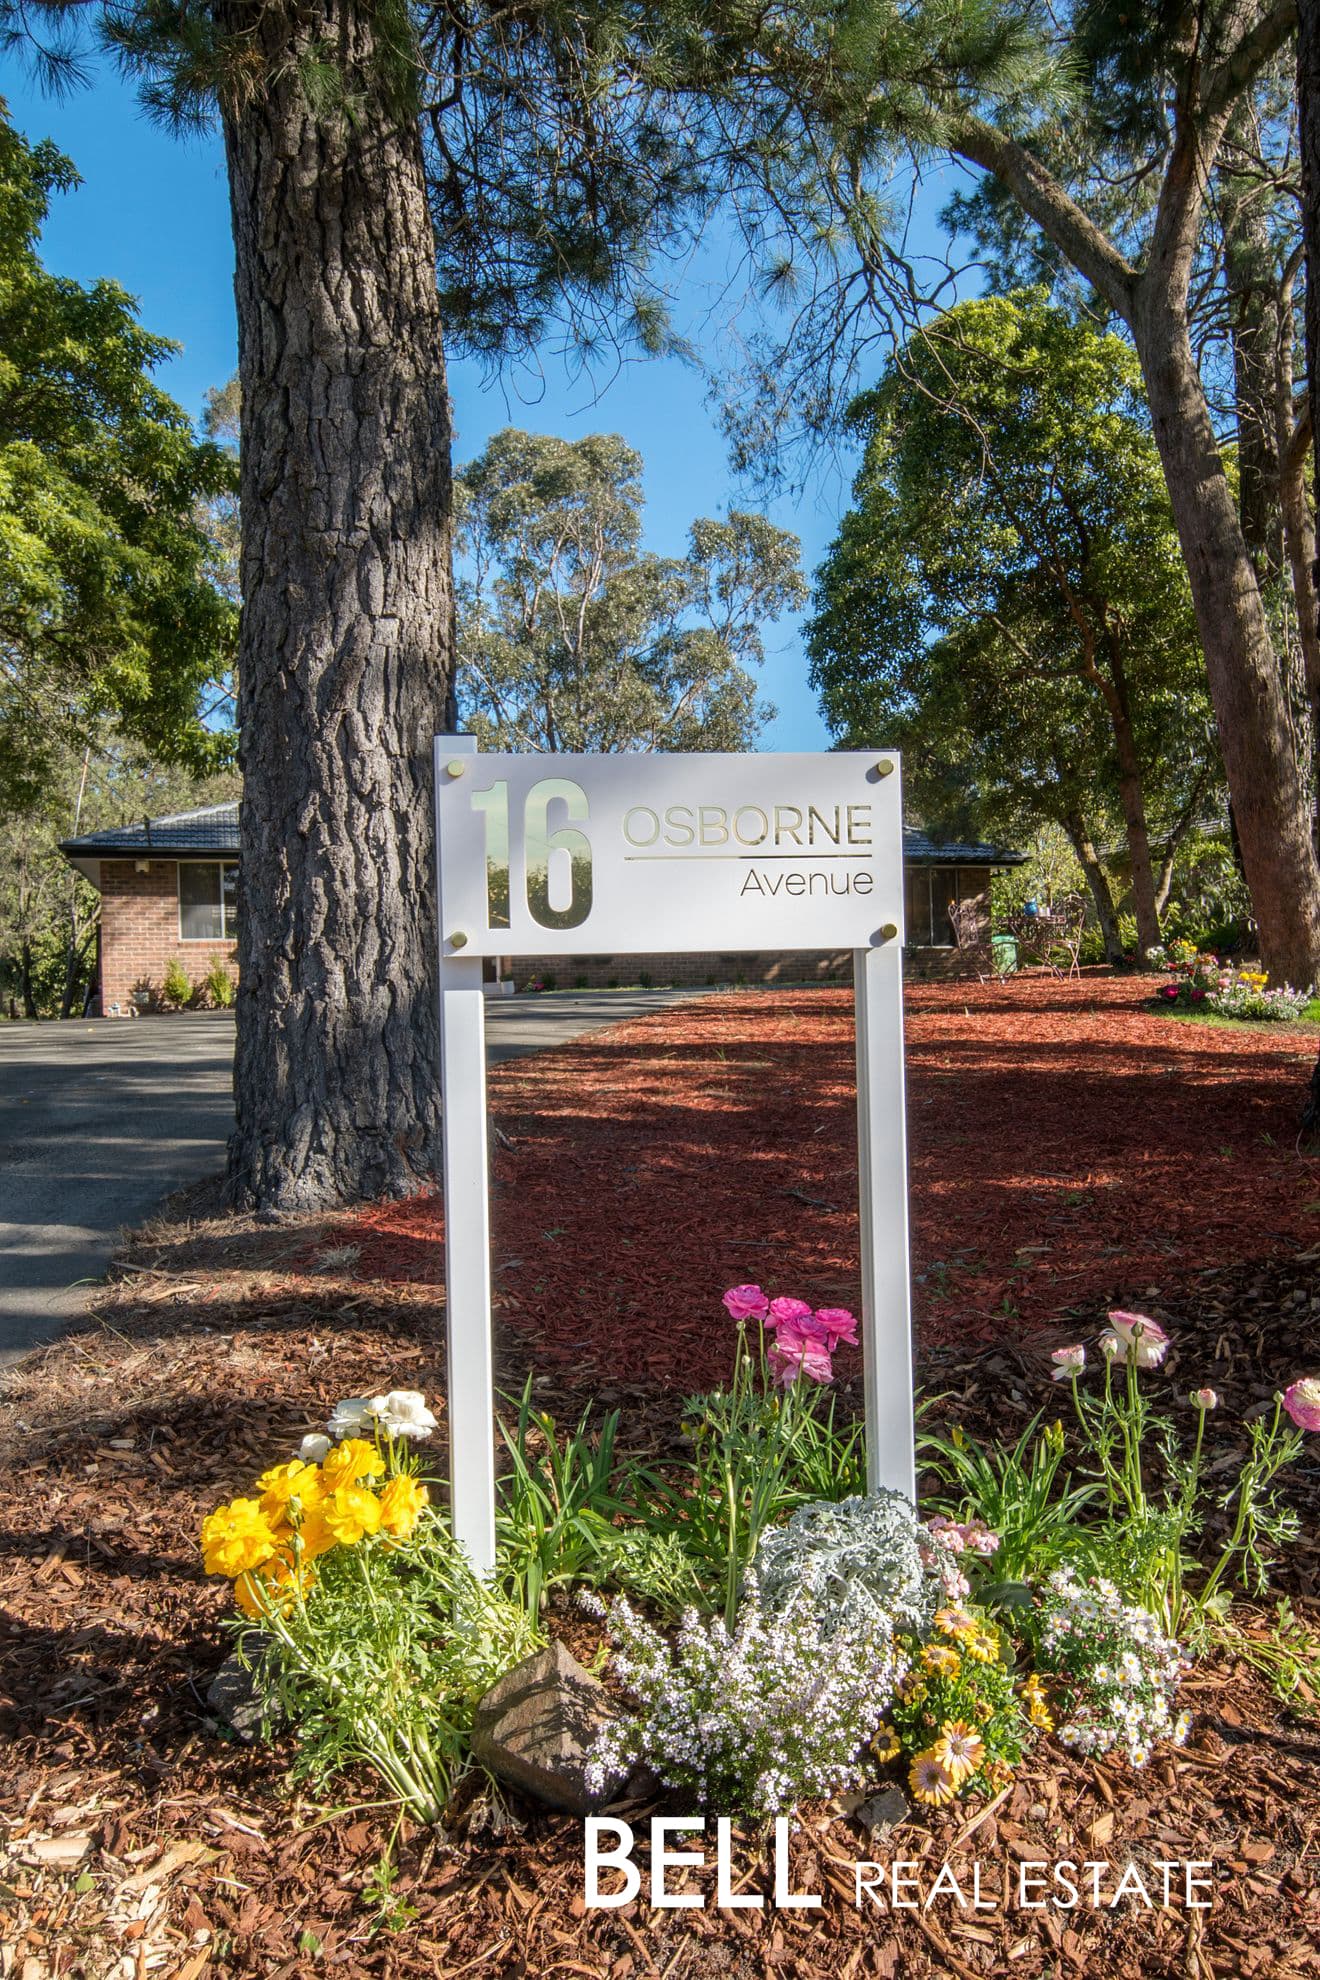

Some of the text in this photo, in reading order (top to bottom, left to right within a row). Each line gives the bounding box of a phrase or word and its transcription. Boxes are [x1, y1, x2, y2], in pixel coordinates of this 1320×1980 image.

[622, 804, 873, 848] OSBORNE
[470, 777, 593, 930] 16
[740, 868, 874, 897] Avenue
